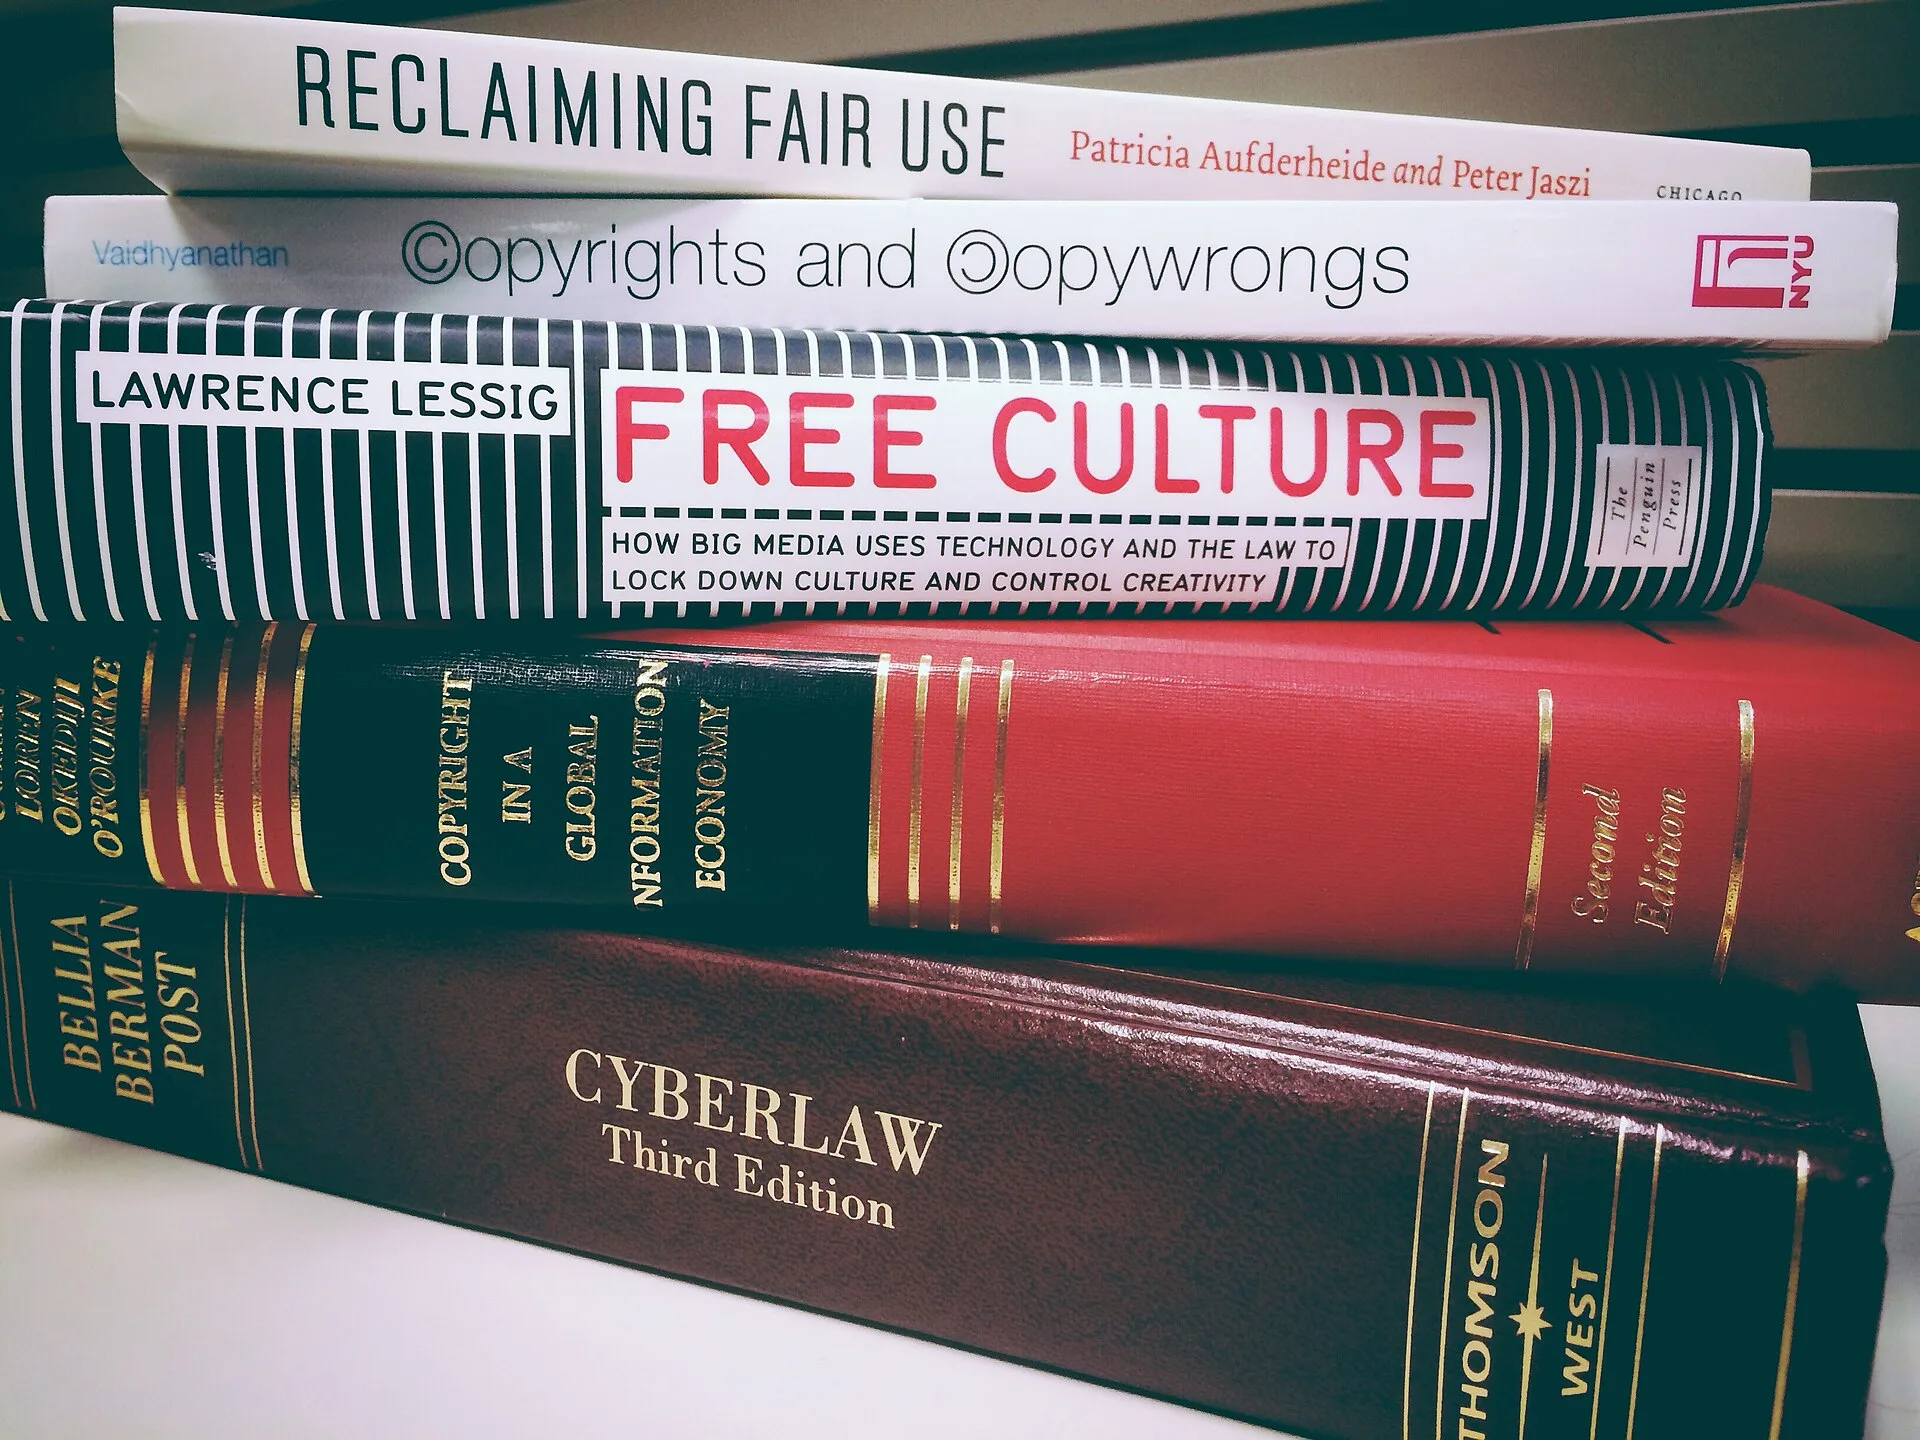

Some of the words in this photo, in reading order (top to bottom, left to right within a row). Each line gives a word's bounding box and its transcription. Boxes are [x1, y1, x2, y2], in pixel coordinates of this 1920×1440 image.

[296, 44, 713, 155] RECLAIMING
[744, 84, 872, 168] FAIR
[902, 98, 1006, 178] USE
[1070, 130, 1189, 169] Patricia
[1199, 140, 1385, 184] Aufderheide
[1393, 155, 1442, 188] and
[1452, 159, 1523, 194] Peter
[1525, 166, 1591, 200] Jaszi
[1656, 184, 1743, 200] CHICAGO
[91, 239, 289, 272] Vaidhyanathan
[797, 228, 916, 289] and
[1788, 235, 1815, 308] NYU
[92, 370, 369, 415] LAWRENCE
[392, 380, 558, 421] LESSIG
[615, 385, 937, 489] FREE
[992, 396, 1476, 498] CULTURE
[611, 532, 679, 555] HOW
[692, 533, 741, 556] BIG
[754, 533, 845, 557] MEDIA
[856, 535, 925, 557] USES
[936, 535, 1115, 559] TECHNOLOGY
[1123, 537, 1176, 560] AND
[1188, 538, 1235, 560] THE
[1245, 539, 1296, 561] LAW
[1305, 540, 1336, 561] TO
[1611, 486, 1628, 521] The
[1633, 462, 1657, 548] Penguin
[1662, 480, 1682, 530] Press
[612, 570, 686, 591] LOCK
[698, 570, 783, 591] DOWN
[794, 571, 914, 592] CULTURE
[924, 571, 981, 592] AND
[991, 571, 1115, 593] CONTROL
[1123, 572, 1267, 594] CREATIVITY
[14, 689, 44, 825] LOREN
[51, 675, 85, 836] OKEDIJI
[438, 671, 473, 886] COPYRIGHT
[501, 780, 532, 824] IN
[502, 747, 532, 774] A
[565, 714, 599, 861] GLOBAL
[629, 657, 669, 911] NFORMATION
[694, 698, 730, 892] ECONOMY
[1570, 783, 1621, 923] Second
[1633, 786, 1687, 935] Edition
[50, 914, 102, 1073] BELLIA
[99, 899, 154, 1105] BERMAN
[154, 951, 205, 1077] POST
[565, 1048, 943, 1176] CYBERLAW
[602, 1123, 720, 1188] Third
[733, 1153, 896, 1229] Edition
[1458, 1138, 1510, 1440] THOMSON
[1561, 1257, 1599, 1397] WEST
